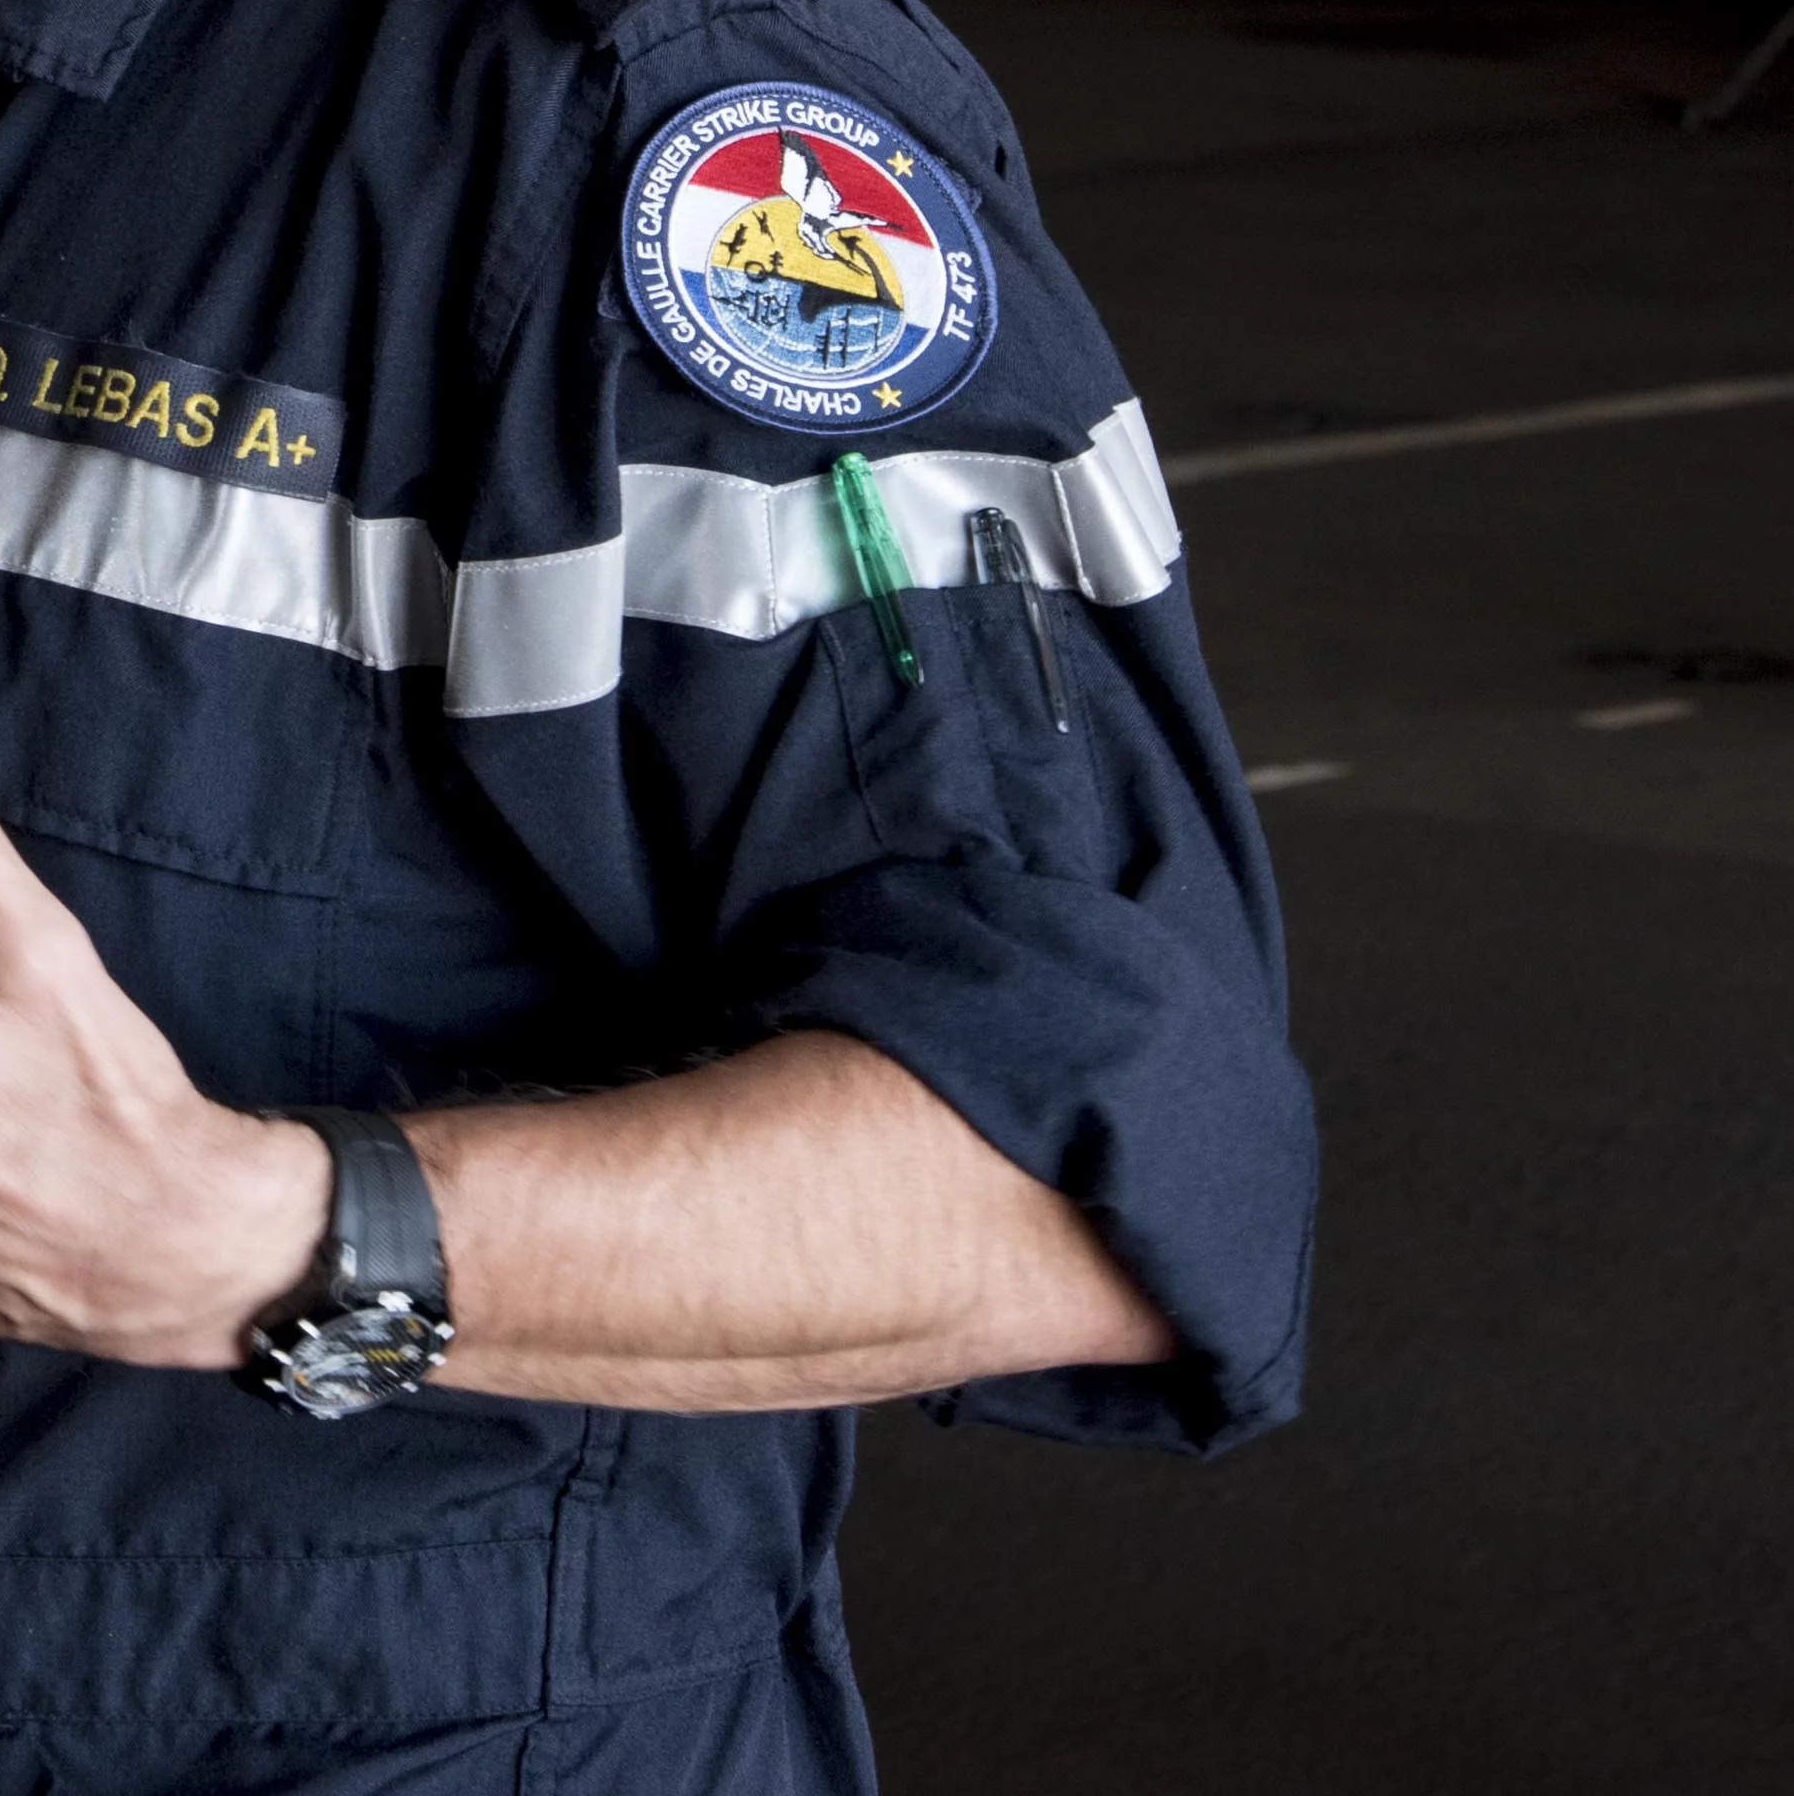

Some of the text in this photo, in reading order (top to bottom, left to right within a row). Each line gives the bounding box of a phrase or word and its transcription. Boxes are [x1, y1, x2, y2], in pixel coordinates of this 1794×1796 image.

[636, 100, 880, 416] CHARLES DE GAULLE CARRIER STRIKE GROUP
[942, 251, 978, 342] TF 473
[31, 357, 221, 449] LEBAS
[235, 407, 317, 468] A+
